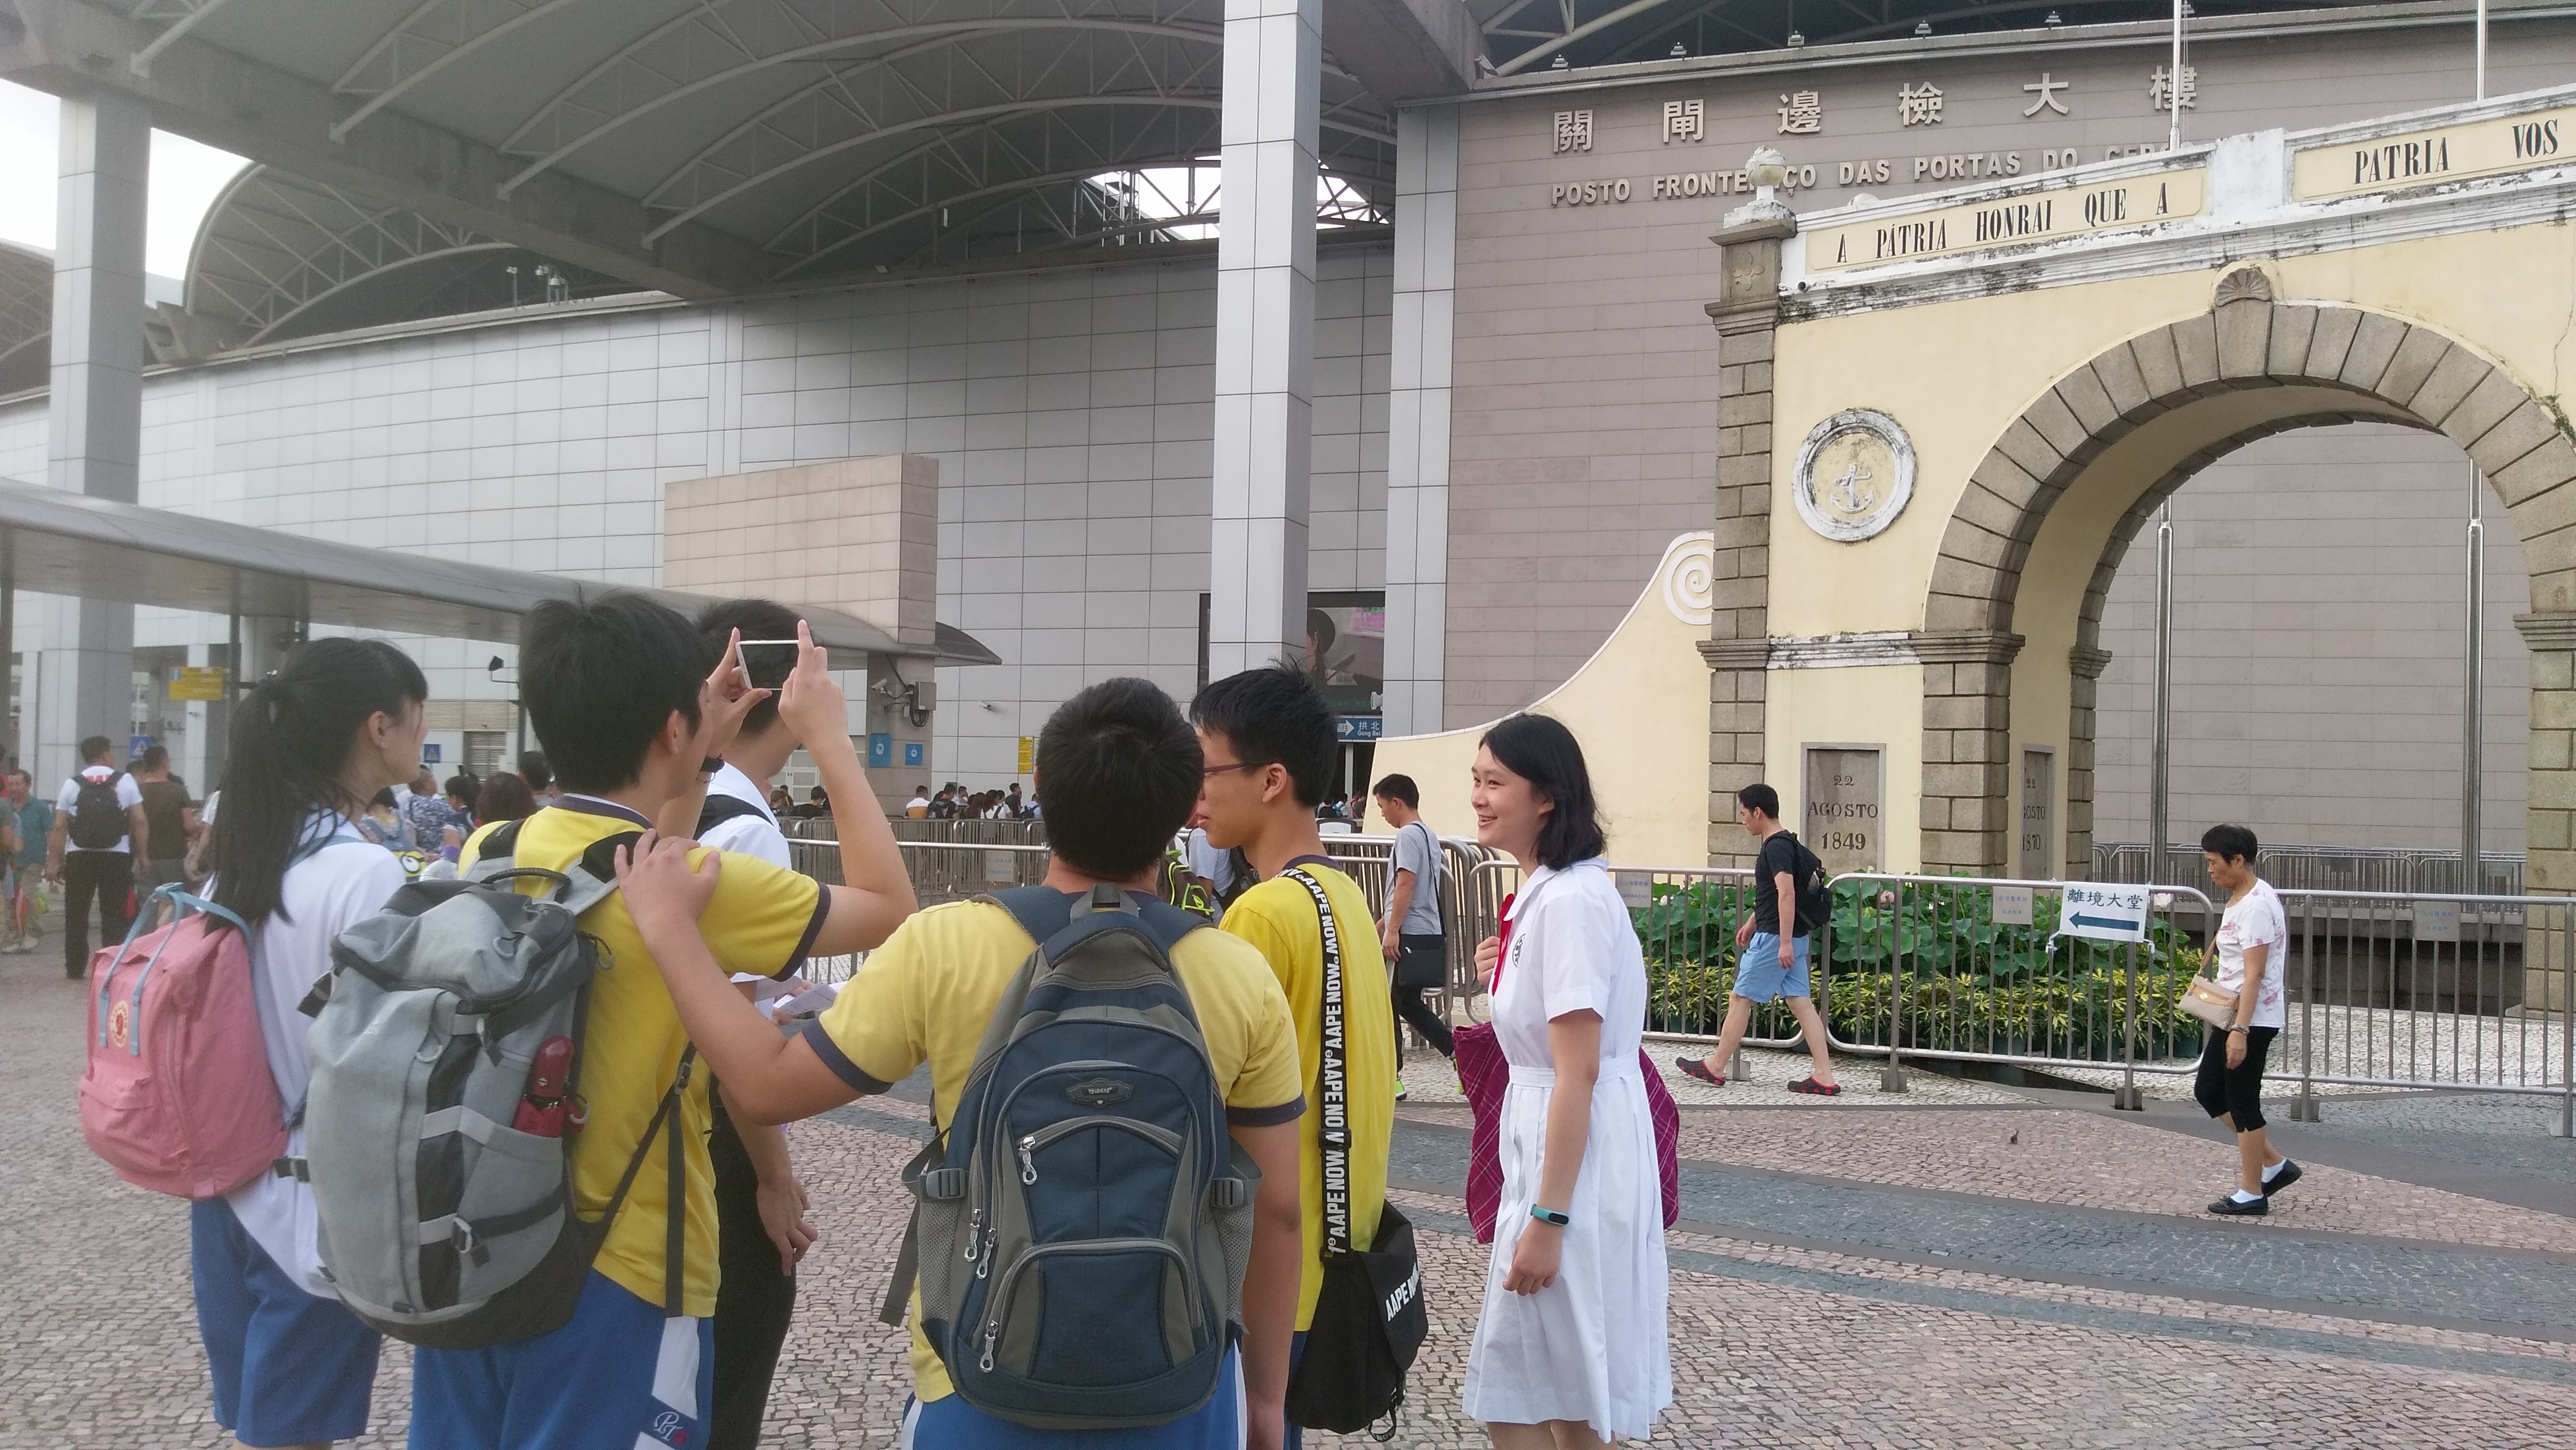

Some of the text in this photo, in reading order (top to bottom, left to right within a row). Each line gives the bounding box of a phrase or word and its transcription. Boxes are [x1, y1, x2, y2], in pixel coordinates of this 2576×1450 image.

[1552, 64, 2197, 153] 關閘邊檢大樓
[2354, 118, 2559, 184] PATRIA VOS
[1551, 178, 1630, 206] POSTO
[1653, 164, 1816, 198] FRONTEÇO
[1839, 159, 1890, 185] DAS
[1914, 151, 2021, 180] PORTAS
[2043, 147, 2078, 172] DO
[1837, 182, 2169, 263] A PÁTRIA HONRAI QUE A
[1358, 721, 1380, 730] 拱北
[1833, 775, 1854, 786] 22
[2026, 778, 2037, 789] 22
[1808, 802, 1879, 819] AGOSTO
[2023, 805, 2046, 821] OSTO
[1821, 832, 1866, 851] 1849
[2023, 833, 2041, 851] 1870
[1300, 877, 1338, 955] AAPE NOW
[2067, 888, 2143, 910] 離境大堂
[1325, 963, 1342, 1049] AAPE NOW
[1324, 1057, 1343, 1102] AAPE
[1325, 1150, 1344, 1191] NOW
[1327, 1192, 1346, 1238] AAPE
[1385, 1282, 1410, 1322] AAPE
